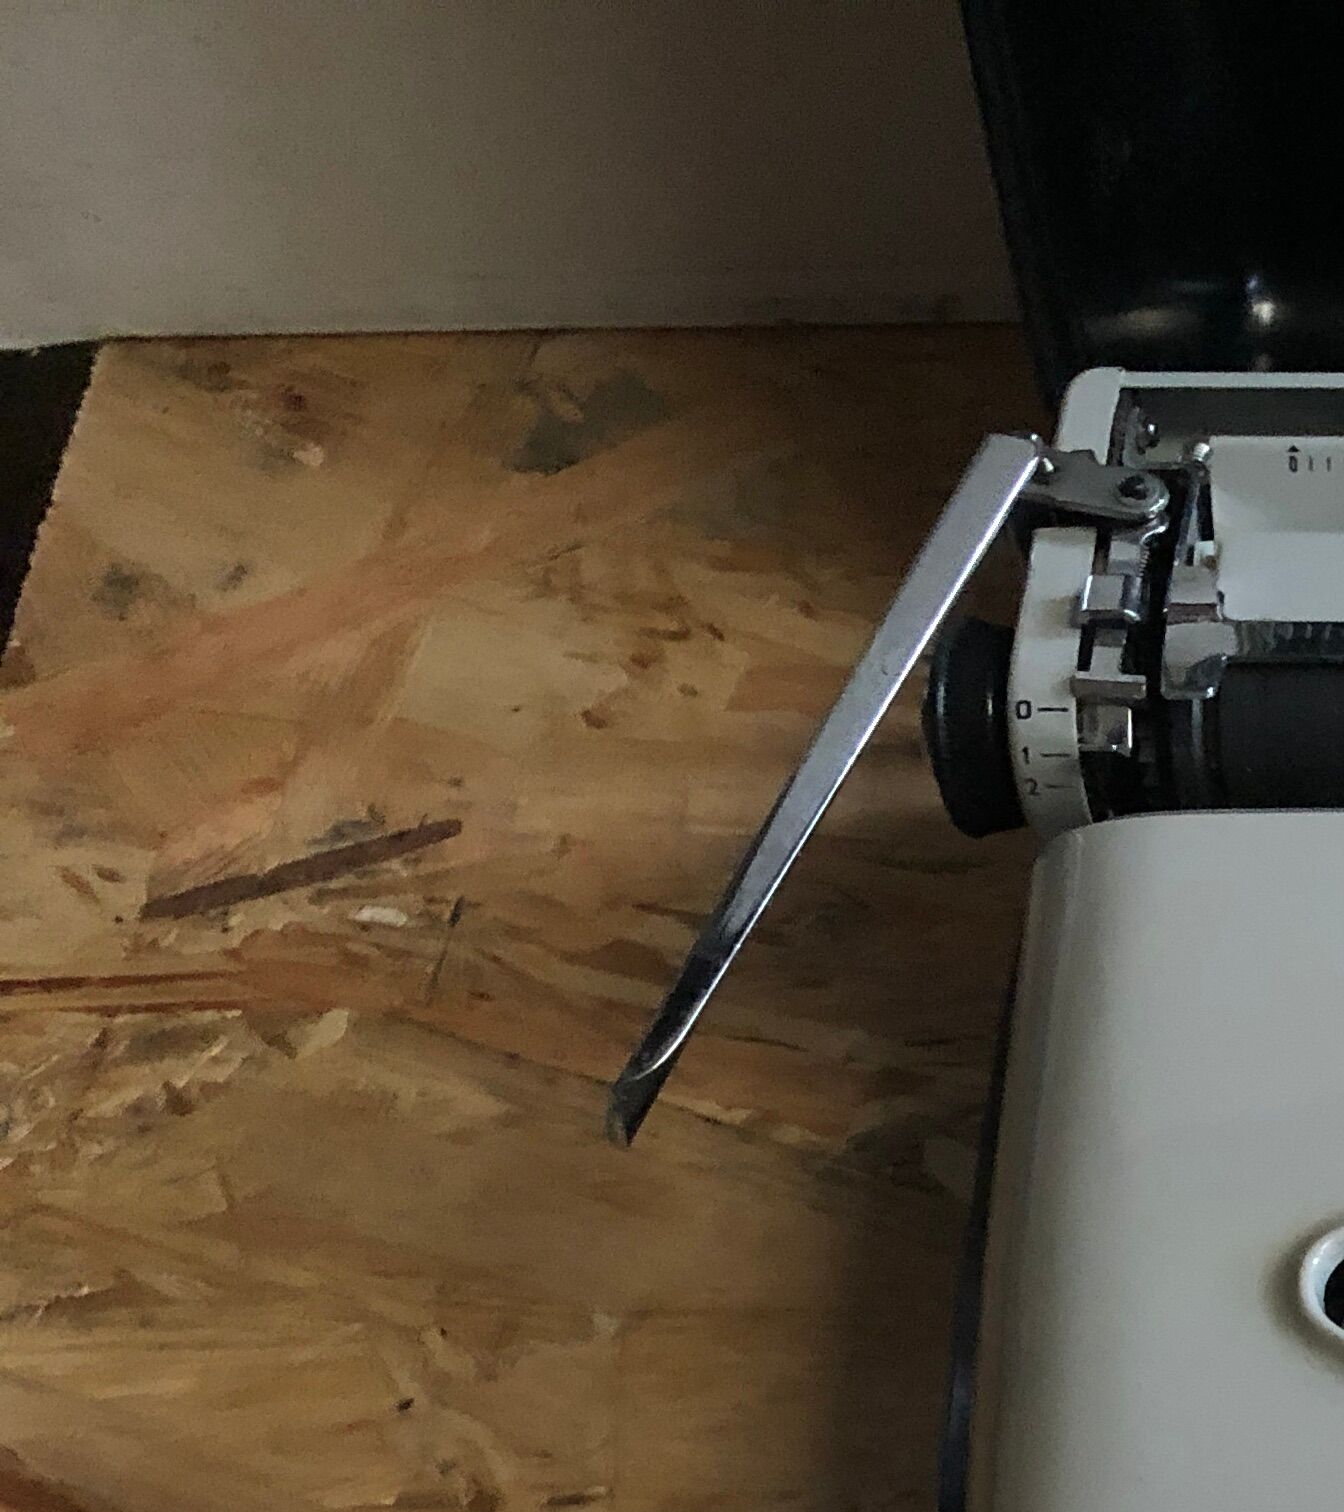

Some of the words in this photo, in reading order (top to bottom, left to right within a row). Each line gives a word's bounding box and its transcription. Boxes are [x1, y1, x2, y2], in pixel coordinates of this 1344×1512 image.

[1289, 455, 1298, 473] 0
[1016, 700, 1032, 720] 0
[1022, 746, 1030, 765] 1
[1024, 778, 1040, 796] 2
